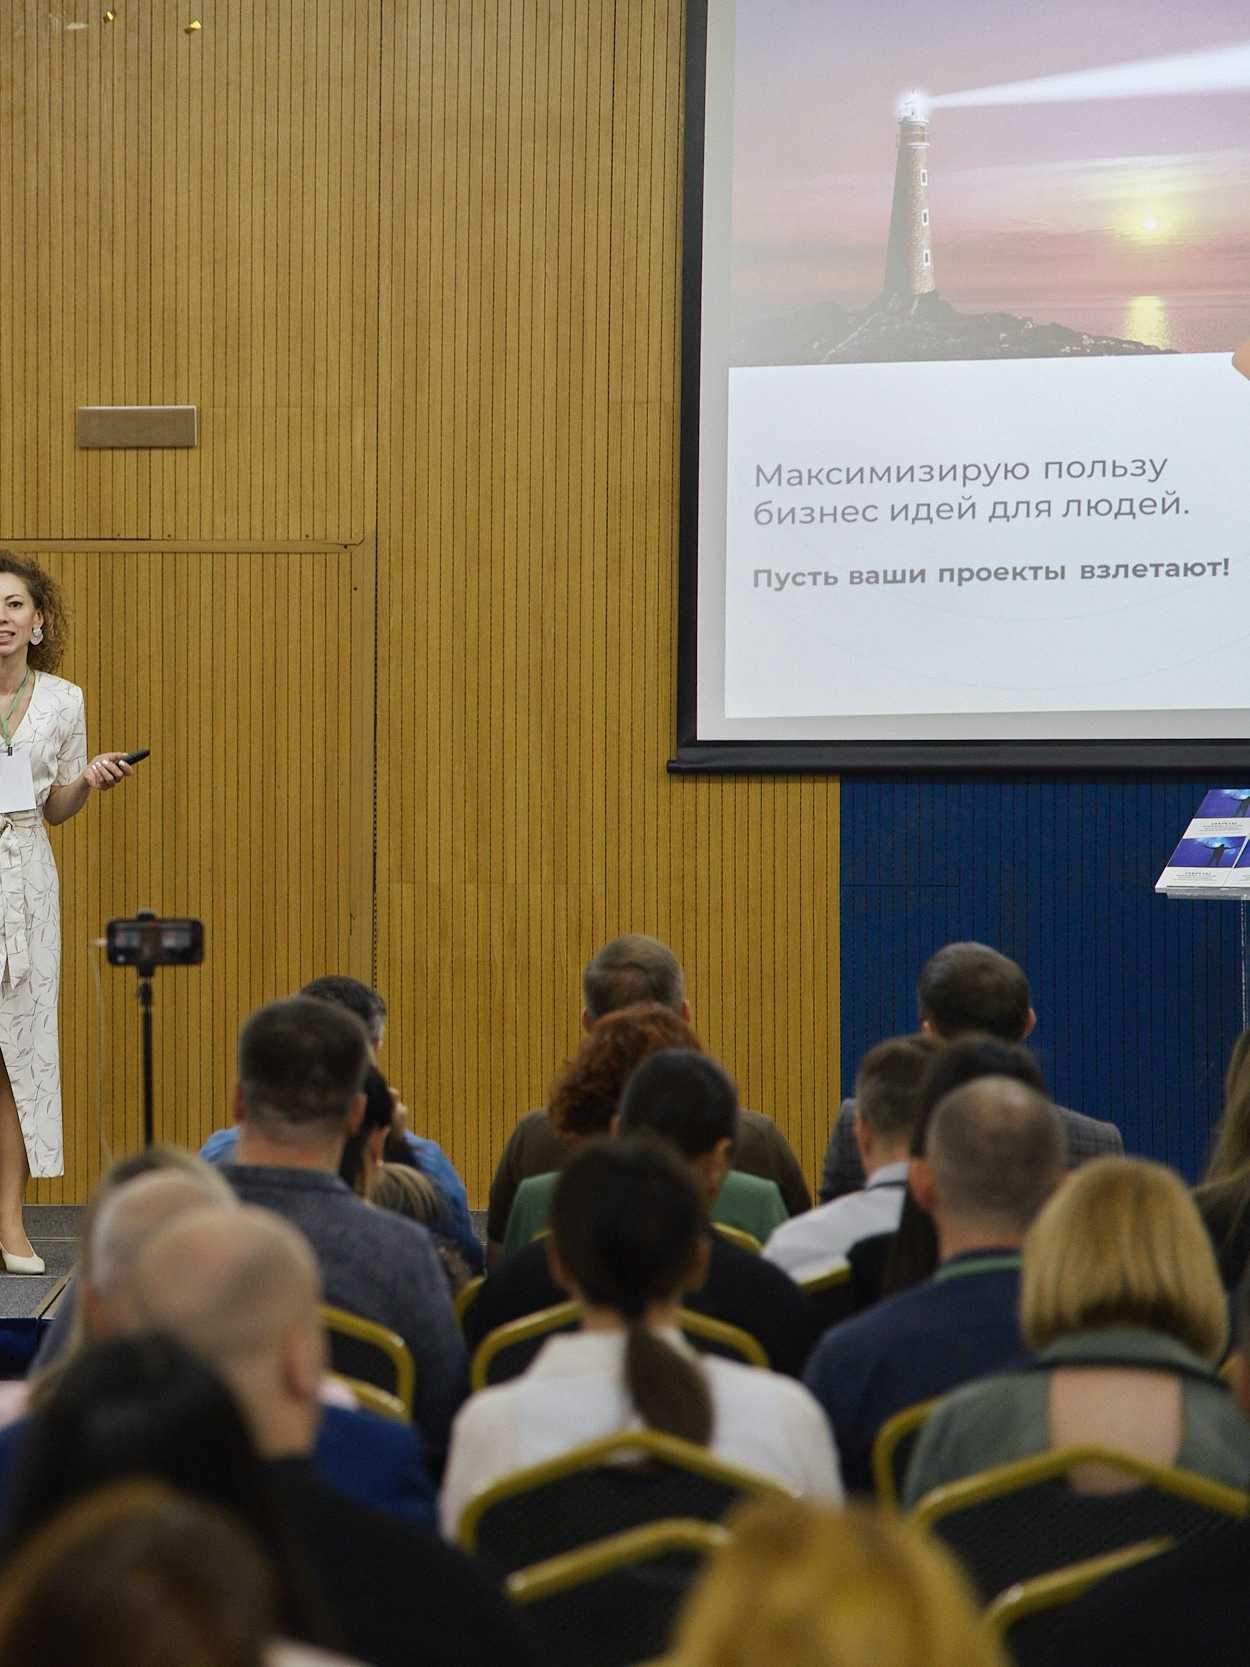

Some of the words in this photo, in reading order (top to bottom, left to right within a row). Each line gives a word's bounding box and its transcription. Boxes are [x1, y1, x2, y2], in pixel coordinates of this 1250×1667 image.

[755, 462, 1030, 488] Максимизирую
[1044, 457, 1169, 484] пользу
[754, 499, 879, 526] бизнес
[890, 495, 977, 526] идей
[988, 499, 1052, 524] для
[1061, 489, 1190, 521] людей.
[753, 568, 839, 592] Пусть
[849, 568, 926, 586] ваши
[938, 564, 1066, 587] проекты
[1080, 557, 1230, 580] взлетают!
